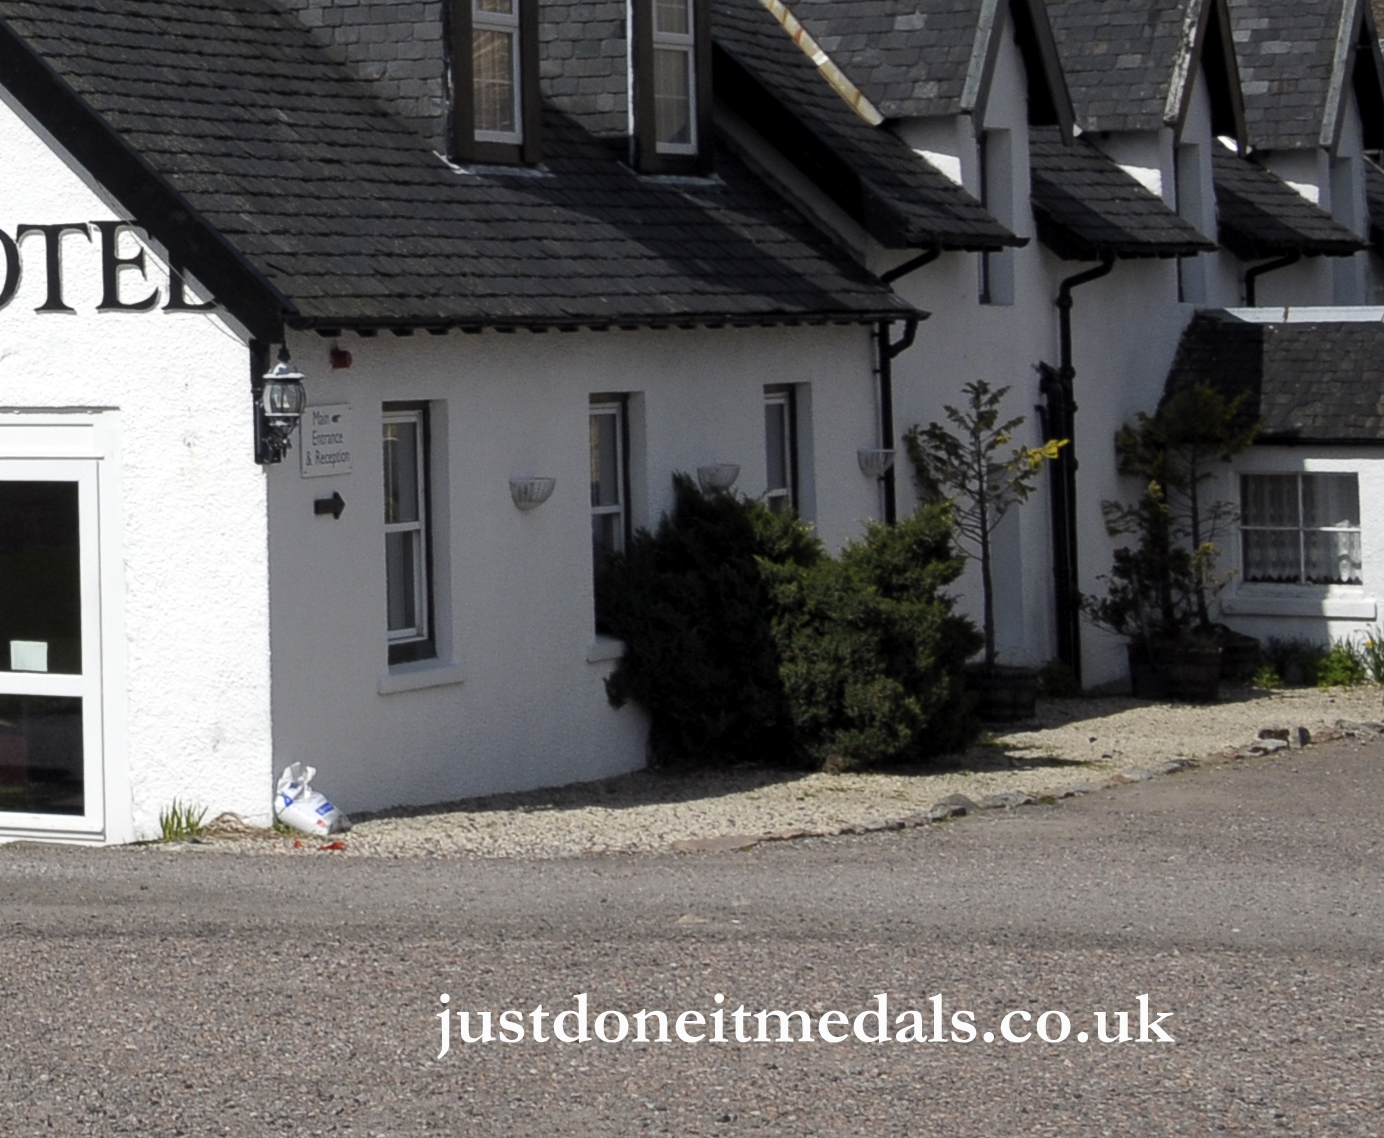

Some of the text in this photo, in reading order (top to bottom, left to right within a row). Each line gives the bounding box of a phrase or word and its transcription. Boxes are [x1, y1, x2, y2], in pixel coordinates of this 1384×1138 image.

[312, 411, 329, 426] Main
[312, 430, 343, 446] Entrance
[315, 449, 350, 468] Reception
